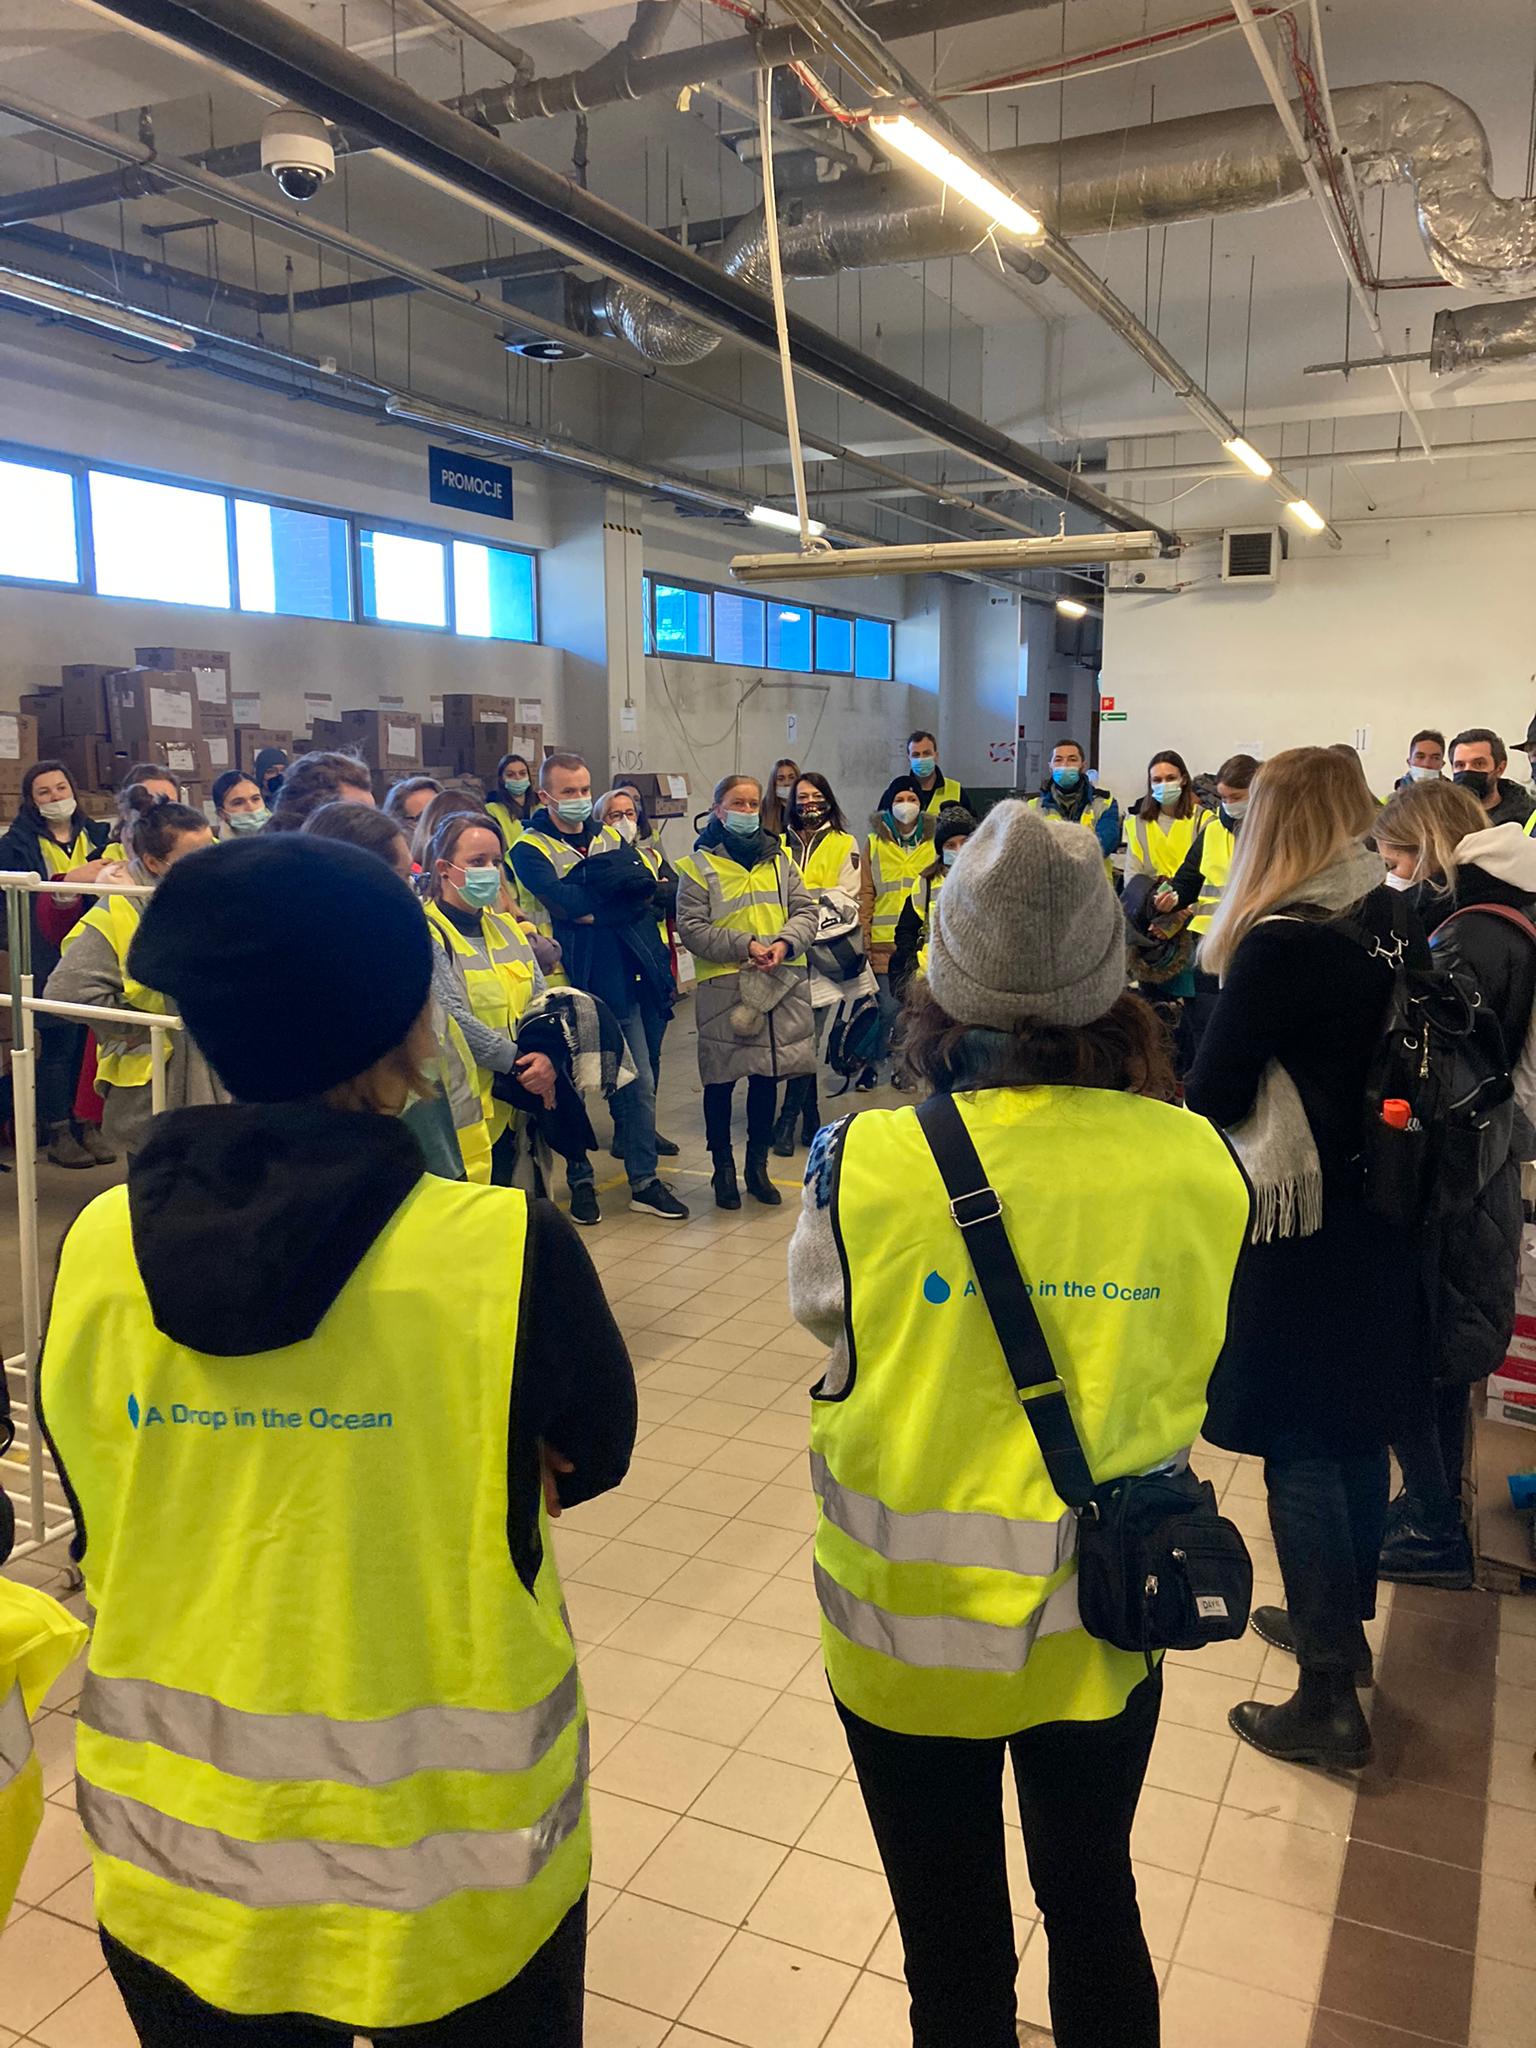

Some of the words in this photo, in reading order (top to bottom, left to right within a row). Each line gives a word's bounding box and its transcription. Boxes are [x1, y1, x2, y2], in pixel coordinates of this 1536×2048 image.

[441, 468, 503, 500] PROMOCJE
[963, 1280, 977, 1297] A
[1039, 1280, 1057, 1297] in
[1063, 1281, 1096, 1298] the
[1102, 1282, 1161, 1301] Ocean
[144, 1406, 165, 1427] A
[171, 1404, 228, 1431] Drop
[234, 1408, 255, 1427] in
[261, 1408, 302, 1428] the
[308, 1407, 393, 1430] Ocean
